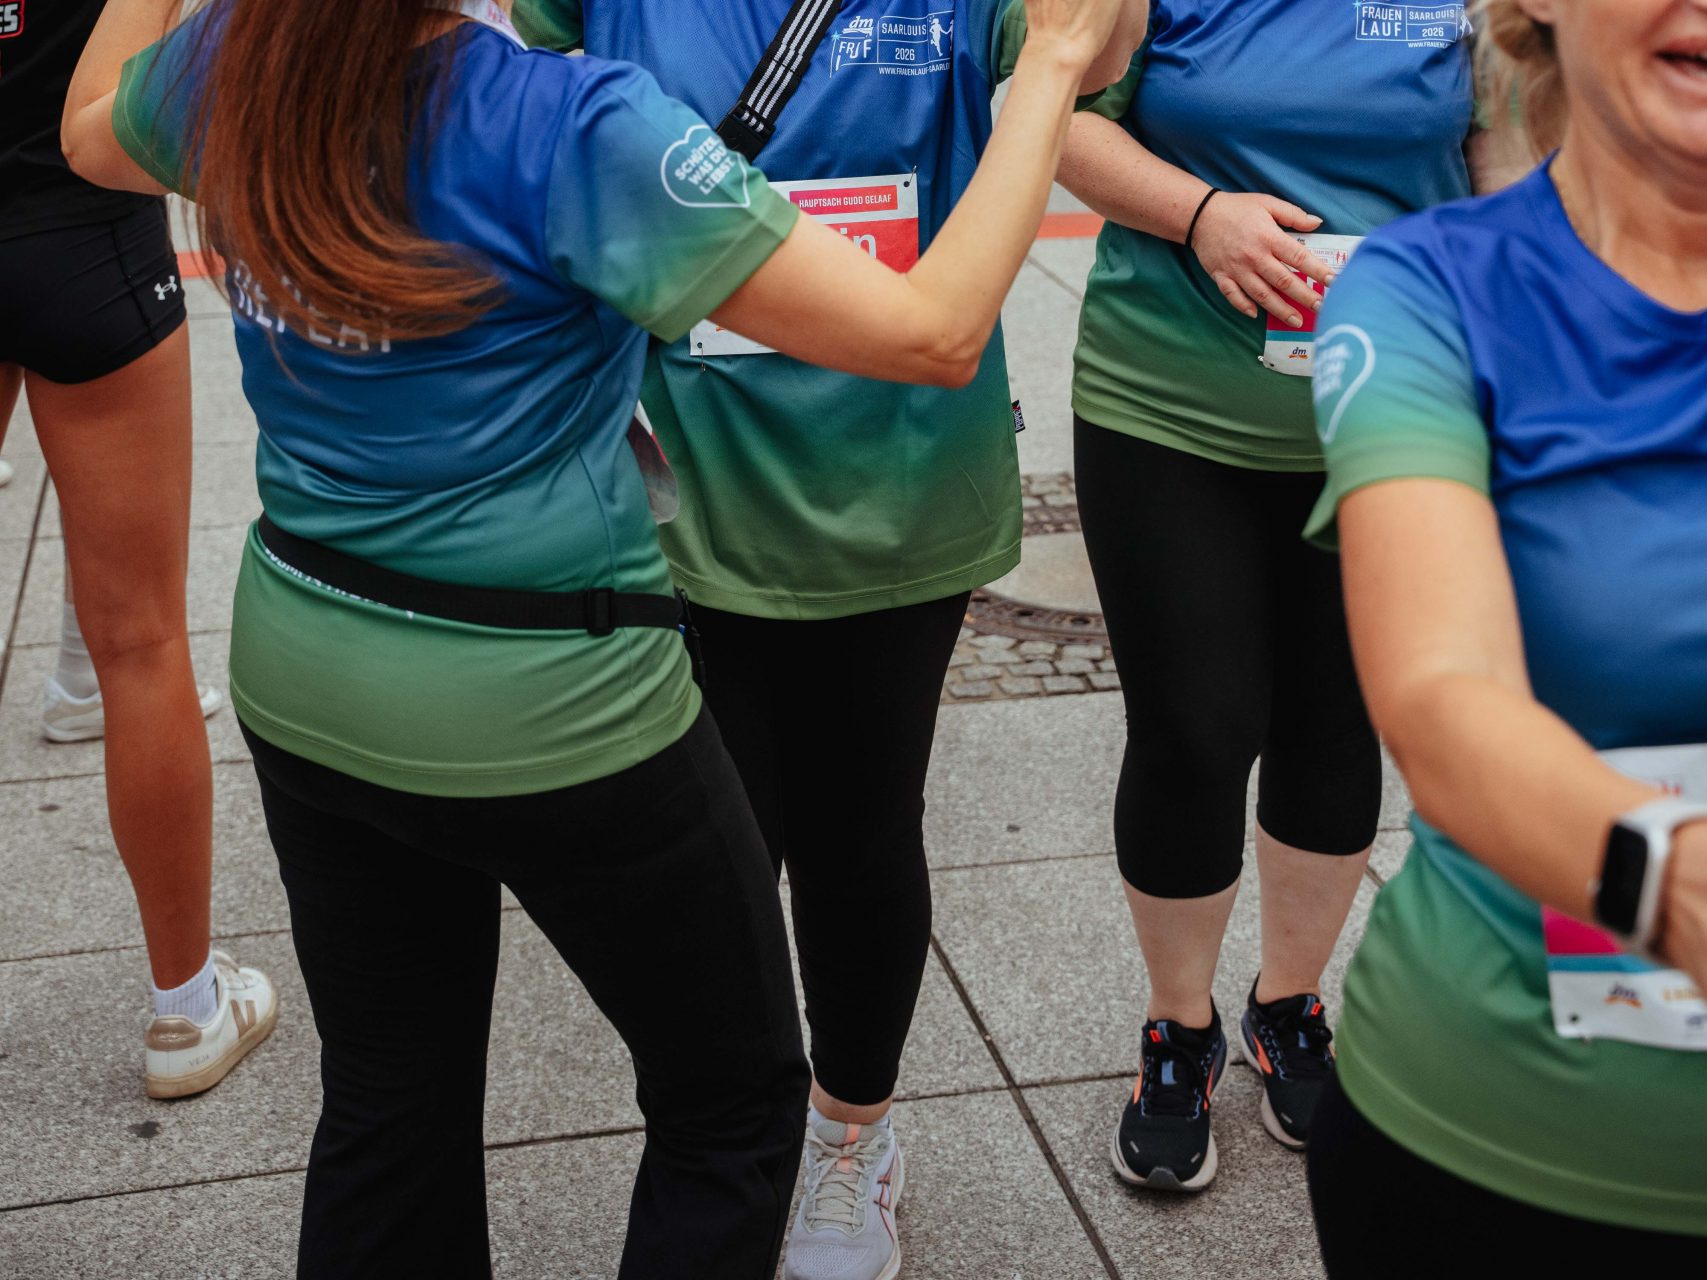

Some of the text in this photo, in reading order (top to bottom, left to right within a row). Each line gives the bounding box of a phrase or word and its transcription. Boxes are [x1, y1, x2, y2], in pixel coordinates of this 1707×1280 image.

[1362, 6, 1402, 21] FRAUEN
[1409, 9, 1455, 20] SAARLOUIS
[848, 16, 873, 28] dm
[1361, 20, 1402, 37] LAUF
[881, 23, 927, 36] SAARLOUIS
[1422, 27, 1444, 37] 2026
[895, 48, 915, 61] 2026
[688, 145, 727, 185] WAS DU
[699, 156, 736, 194] LIEBST
[799, 194, 892, 208] HAUPTSACH GUDD GELAAF
